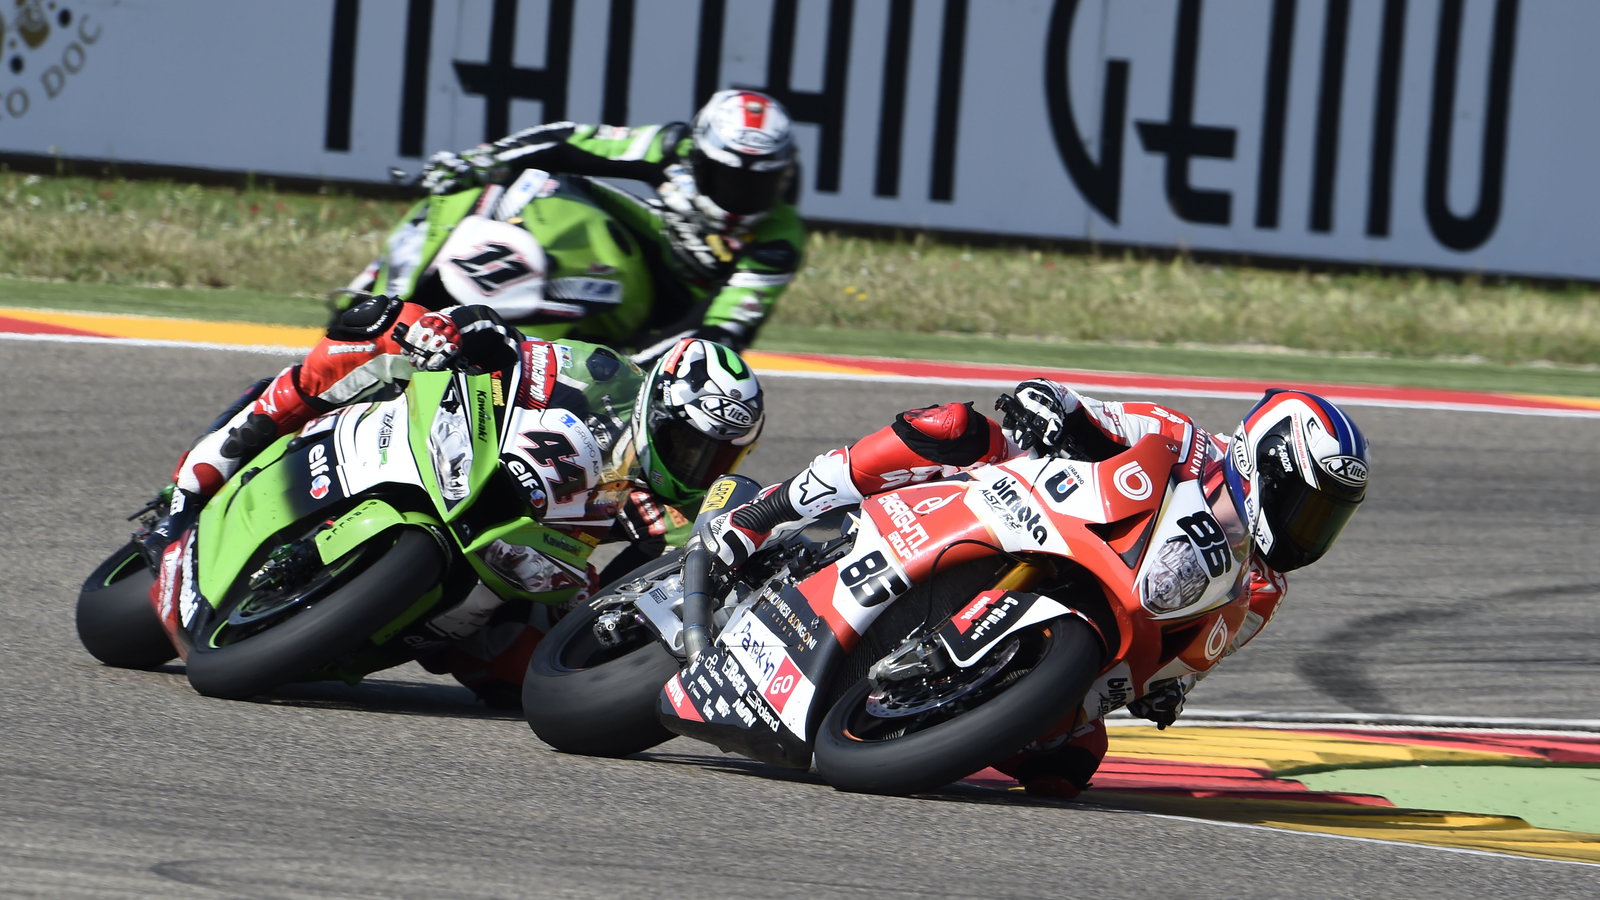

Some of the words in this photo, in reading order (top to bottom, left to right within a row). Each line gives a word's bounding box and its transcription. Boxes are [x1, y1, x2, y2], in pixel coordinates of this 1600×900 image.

[41, 12, 103, 99] DOC
[475, 389, 488, 444] Kawasaki
[711, 398, 751, 424] X-lite
[308, 443, 330, 477] elf
[574, 426, 596, 458] GRUPO
[507, 460, 539, 490] elf
[519, 431, 588, 503] 44
[1332, 458, 1367, 480] X-lite
[992, 476, 1048, 546] bimota
[887, 531, 916, 561] GROUP
[1176, 510, 1232, 579] 86
[840, 550, 908, 608] 86
[970, 596, 1019, 640] PIRELLI
[728, 659, 748, 697] Beta
[754, 700, 779, 732] Roland
